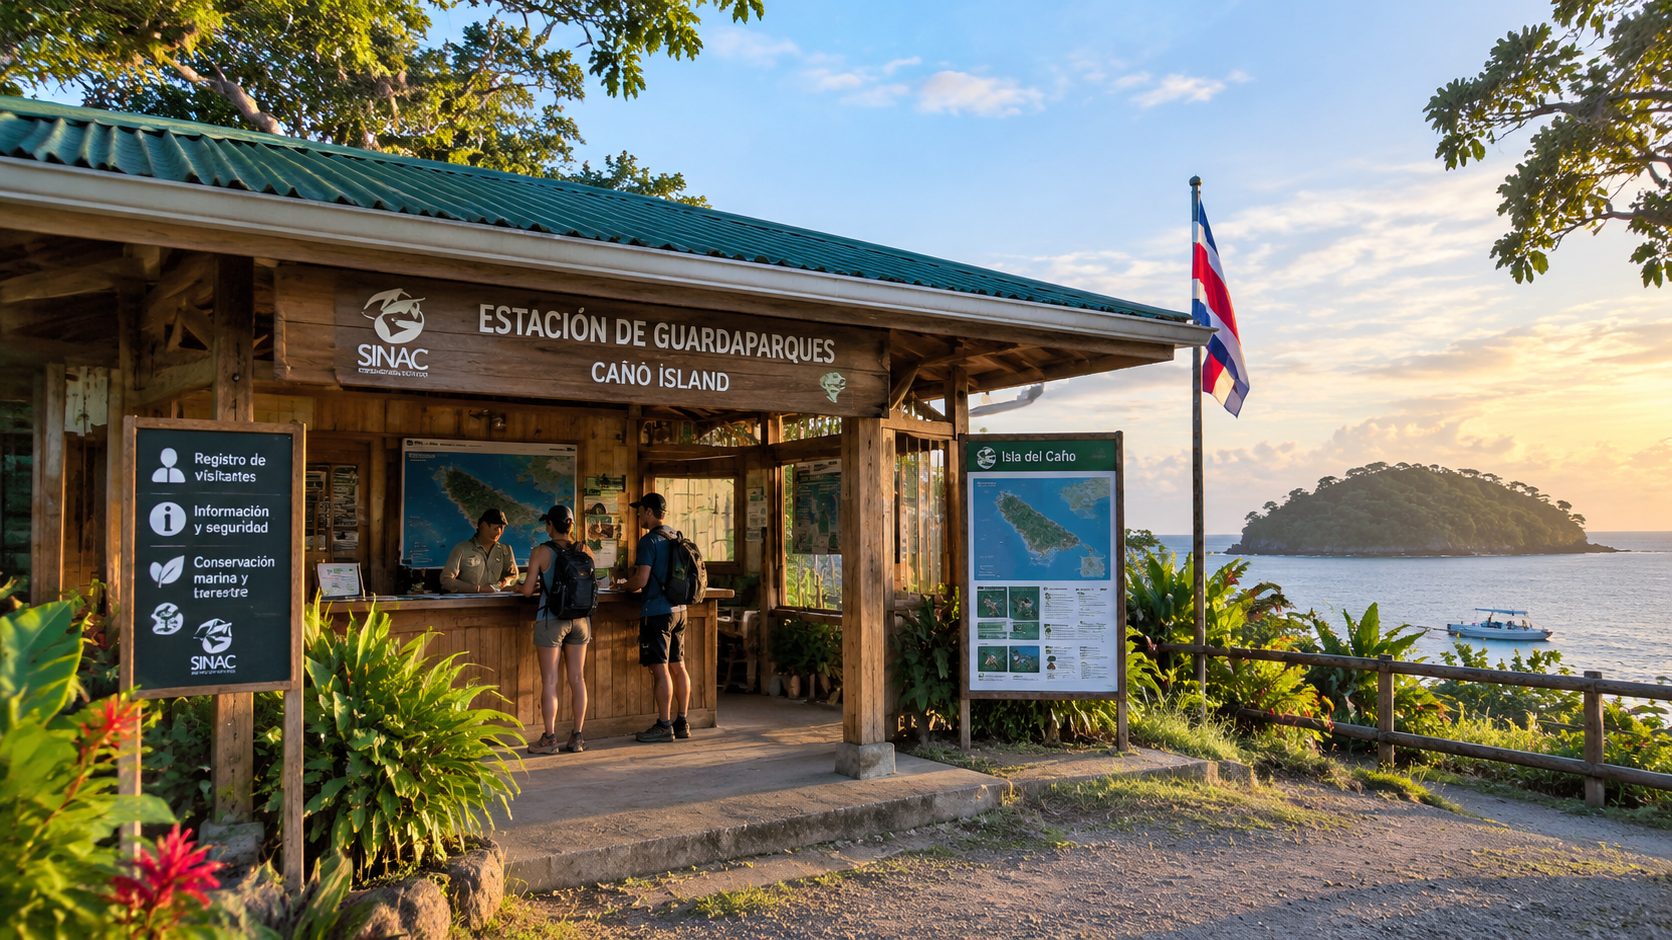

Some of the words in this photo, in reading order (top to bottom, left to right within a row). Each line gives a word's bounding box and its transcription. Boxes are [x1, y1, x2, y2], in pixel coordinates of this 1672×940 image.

[479, 304, 607, 343] ESTACIÓN
[615, 319, 647, 347] DE
[654, 322, 836, 364] GUARDAPARQUES
[357, 343, 429, 371] SINAC
[194, 452, 247, 468] Registro
[249, 452, 267, 467] de
[1002, 450, 1022, 462] Isla
[1024, 450, 1042, 462] del
[194, 504, 270, 518] Información
[194, 523, 203, 536] y
[206, 520, 269, 537] seguridad
[193, 555, 275, 569] Conservación
[193, 572, 238, 585] marina
[240, 573, 249, 587] y
[190, 655, 237, 671] SINAC
